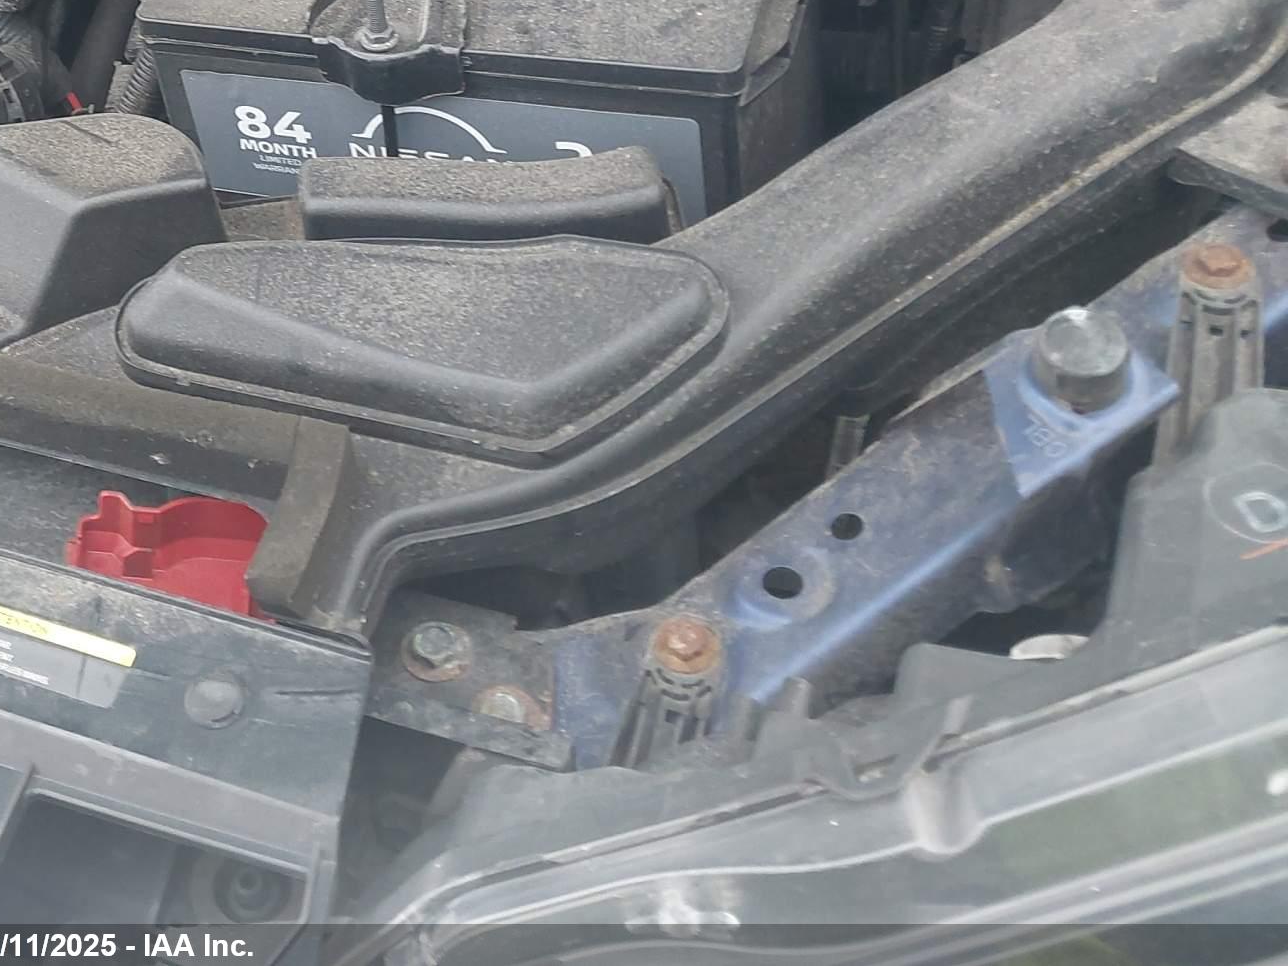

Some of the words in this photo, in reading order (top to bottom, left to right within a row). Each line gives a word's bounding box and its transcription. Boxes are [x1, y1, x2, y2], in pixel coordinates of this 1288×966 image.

[234, 105, 313, 144] 84
[239, 138, 318, 159] MONTH
[258, 154, 303, 166] LIMITED
